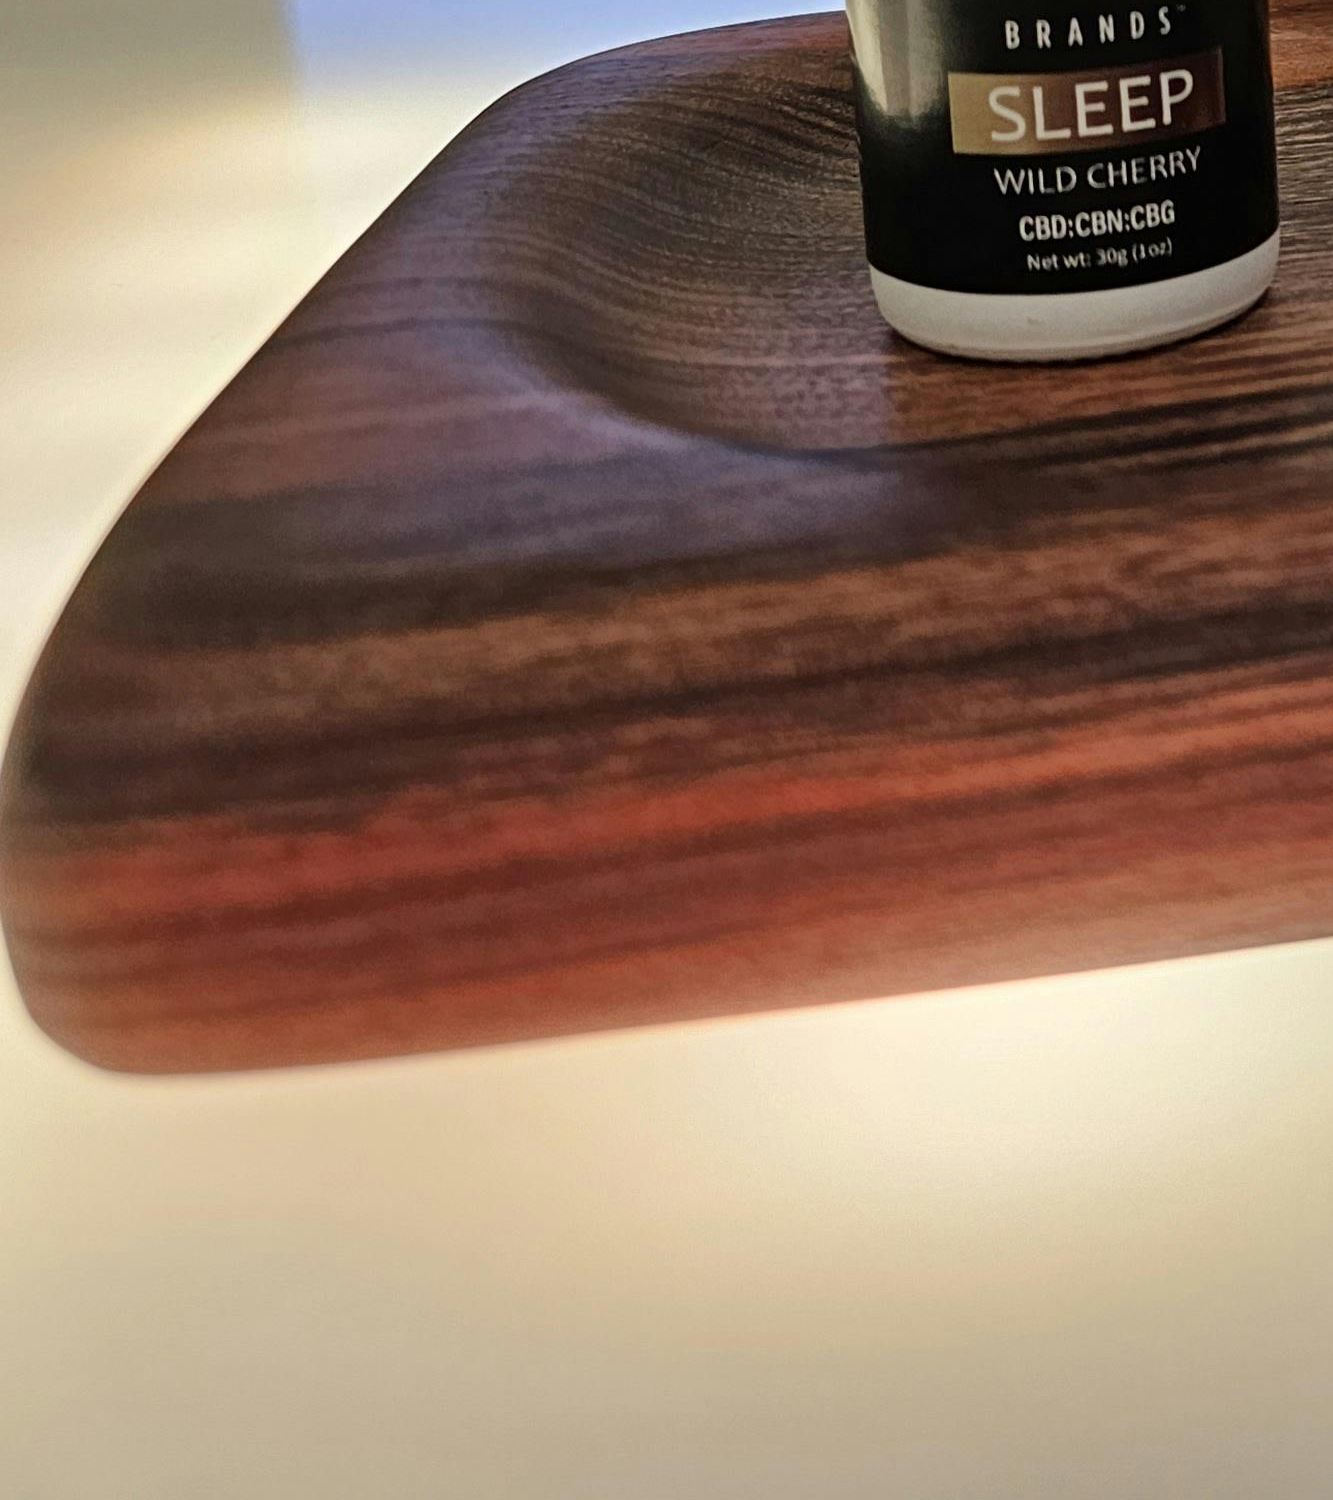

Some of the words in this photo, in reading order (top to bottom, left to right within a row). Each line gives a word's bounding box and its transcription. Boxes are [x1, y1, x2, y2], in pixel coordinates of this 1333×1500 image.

[988, 68, 1194, 142] SLEEP
[993, 165, 1078, 196] WILD
[1087, 145, 1201, 189] CHERRY
[1019, 199, 1176, 242] CBD:CBN:CBG
[1026, 252, 1059, 272] Net
[1096, 246, 1129, 268] 30g
